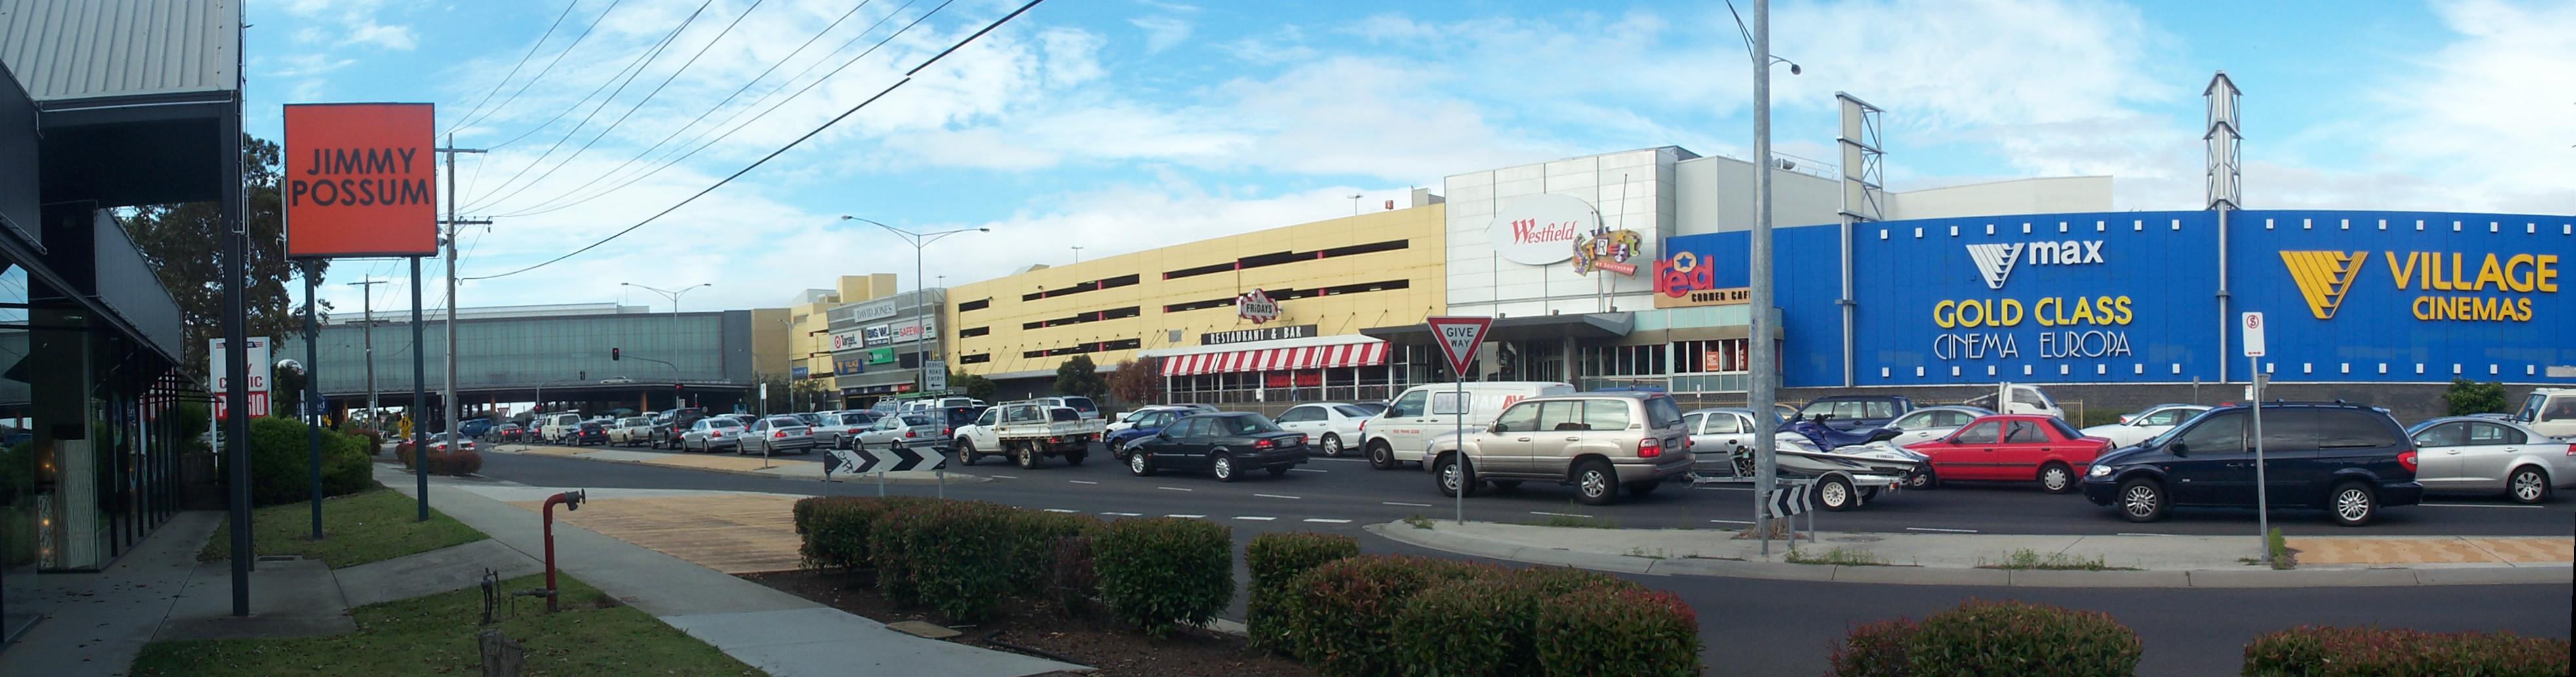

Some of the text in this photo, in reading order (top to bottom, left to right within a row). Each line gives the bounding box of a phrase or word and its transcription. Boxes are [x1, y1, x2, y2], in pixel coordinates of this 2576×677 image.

[307, 148, 416, 175] JIMMY
[292, 178, 429, 206] POSSUM
[1511, 218, 1577, 245] Westfield
[2029, 240, 2104, 265] max
[1653, 255, 1714, 298] red
[2385, 251, 2558, 293] VILLAGE
[1692, 291, 1751, 302] CORNER CAF
[2413, 297, 2531, 321] CINEMAS
[857, 305, 892, 319] DAVID JONES
[1934, 296, 2133, 328] GOLD CLASS
[1210, 326, 1301, 344] RESTAURANT & BAR
[1446, 327, 1474, 337] GIVE
[1934, 331, 2131, 359] CINEMA EUROPA
